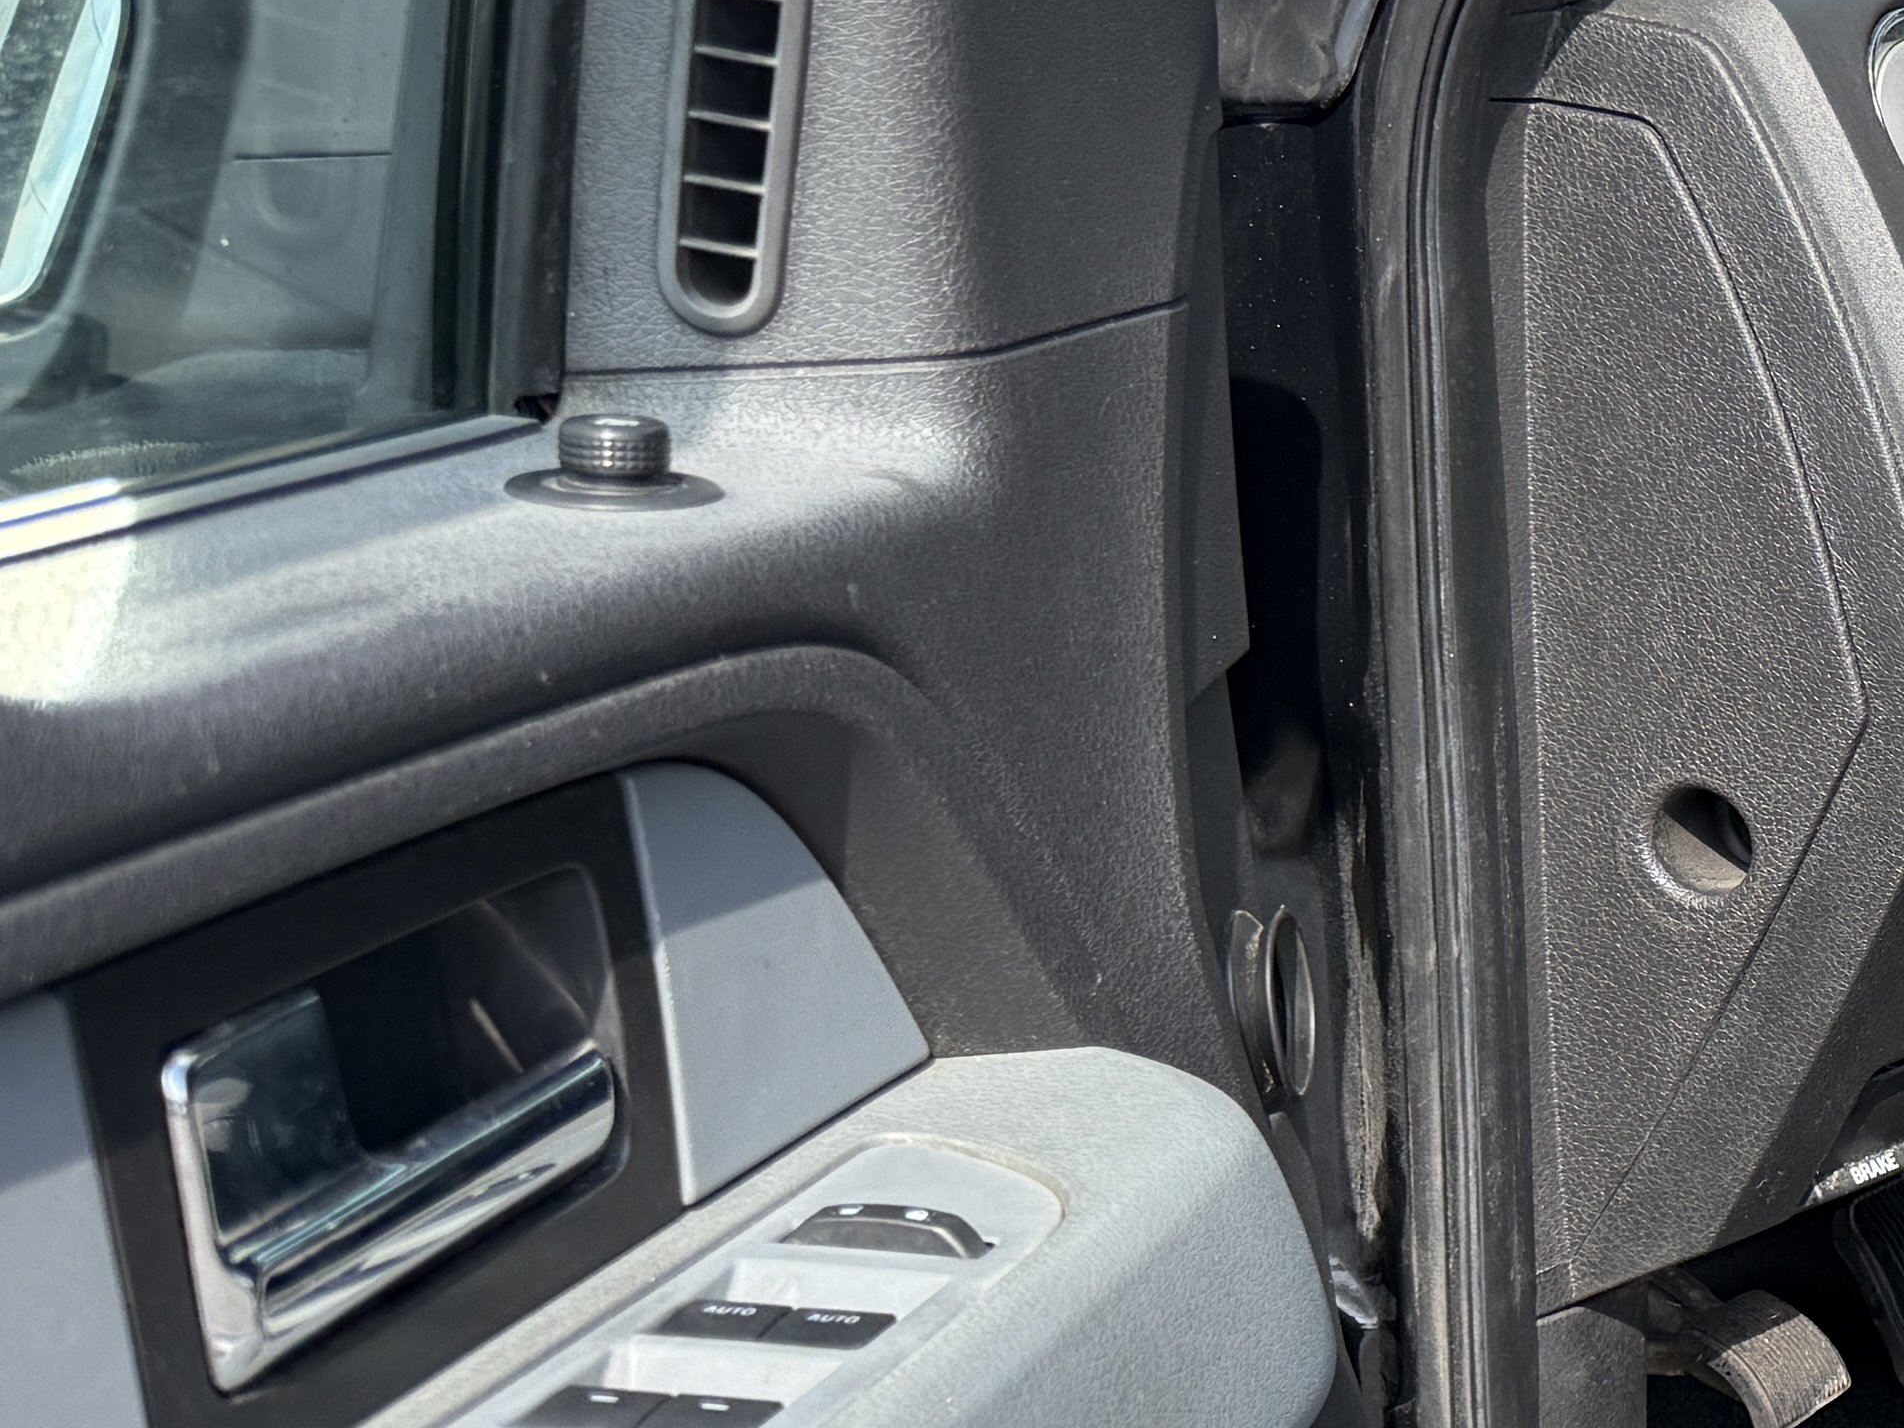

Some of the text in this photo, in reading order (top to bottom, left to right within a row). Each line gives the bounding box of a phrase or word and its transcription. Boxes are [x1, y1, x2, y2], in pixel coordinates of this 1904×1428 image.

[1849, 1152, 1900, 1185] BRAKE
[702, 1304, 861, 1324] AUTO AUTO
